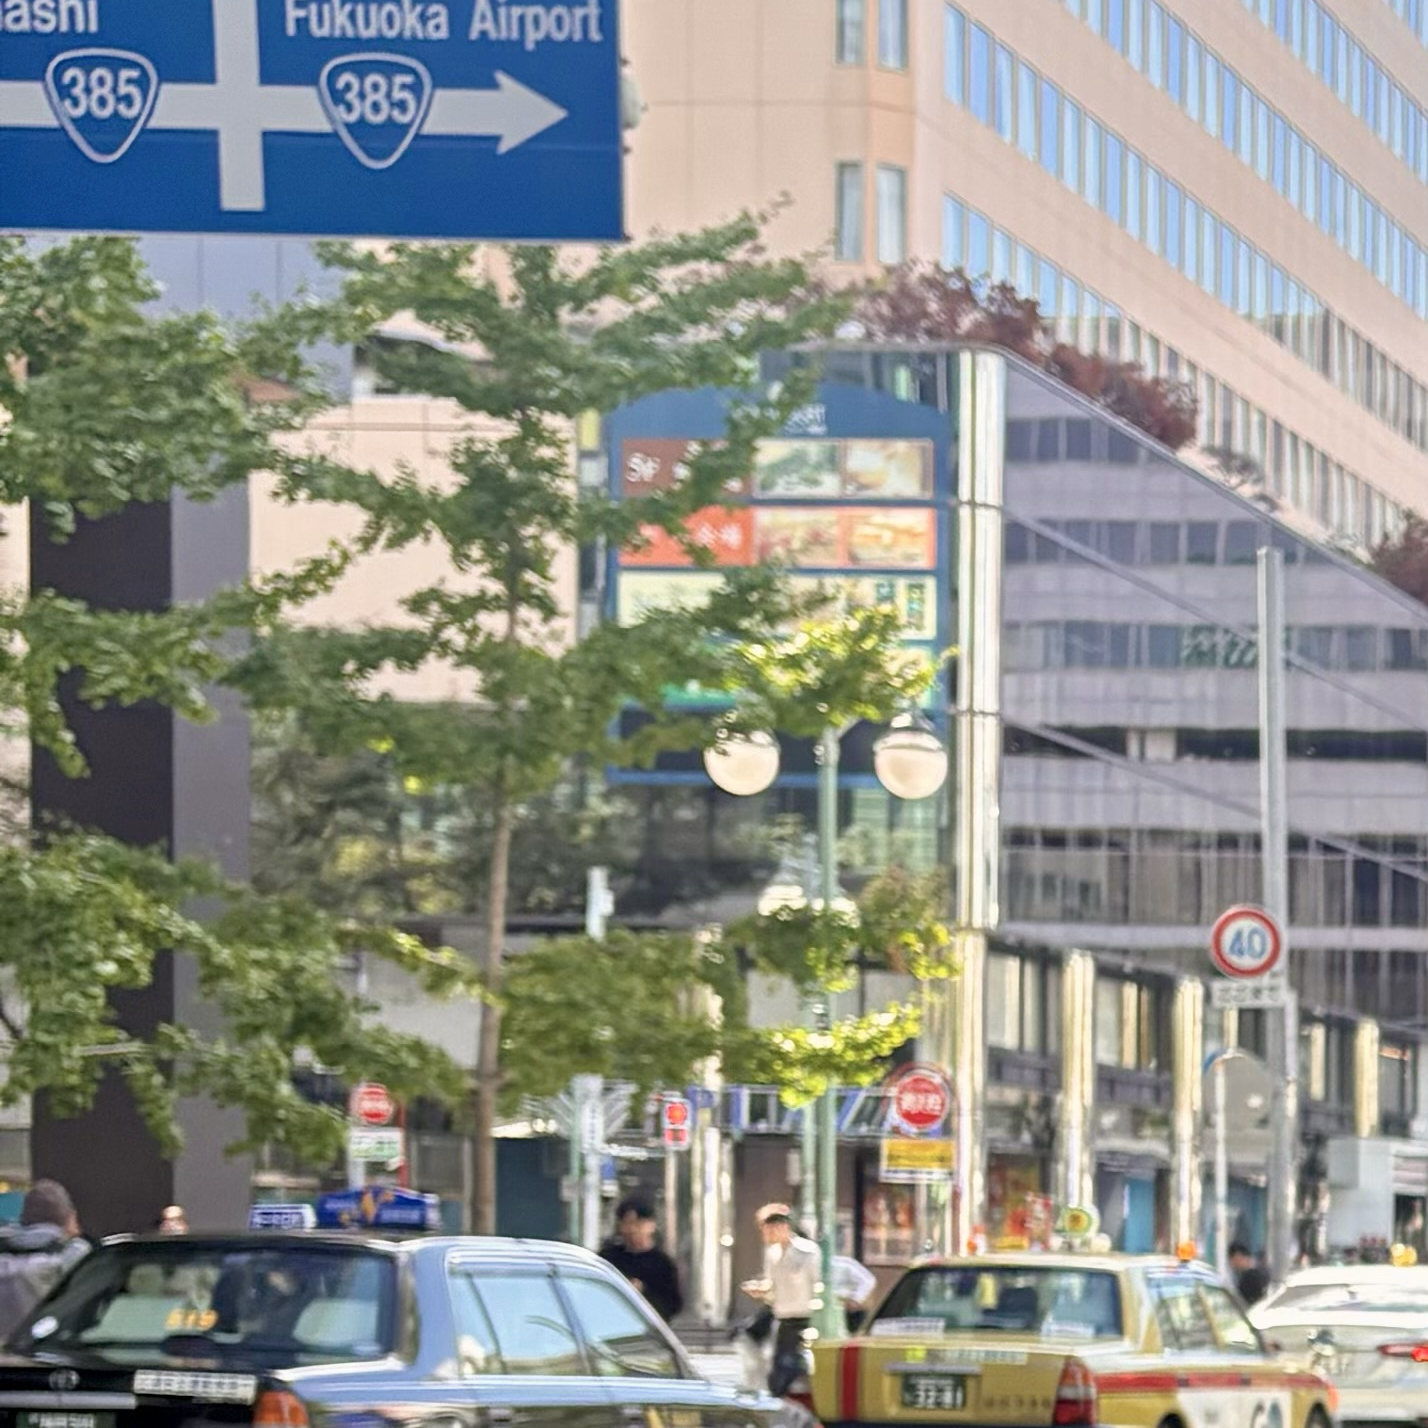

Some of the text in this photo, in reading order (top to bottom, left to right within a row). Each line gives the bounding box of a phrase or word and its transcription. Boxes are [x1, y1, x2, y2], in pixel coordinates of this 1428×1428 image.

[0, 0, 99, 33] ashi
[284, 0, 604, 51] Fukuoka Airport
[62, 66, 142, 119] 385
[335, 71, 417, 125] 385
[1228, 926, 1267, 959] 40
